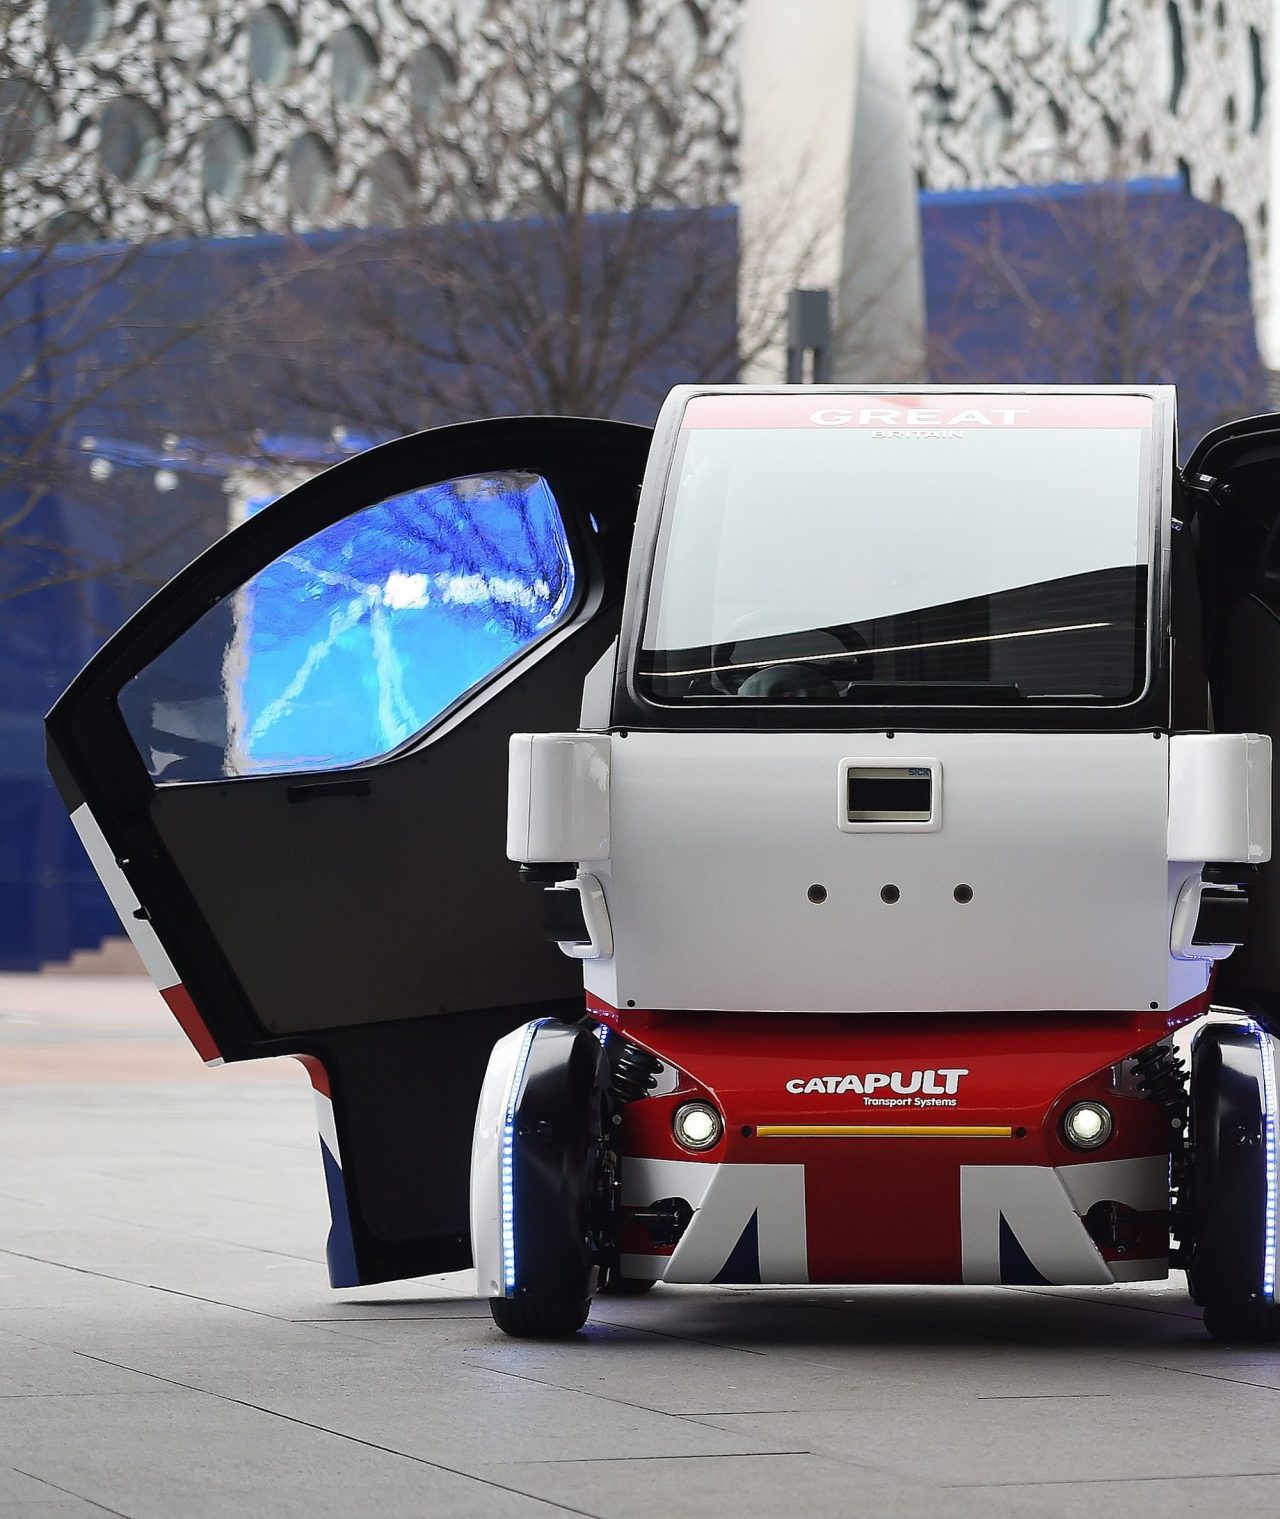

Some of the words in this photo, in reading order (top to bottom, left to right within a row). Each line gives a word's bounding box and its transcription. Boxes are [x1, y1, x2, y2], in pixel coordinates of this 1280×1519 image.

[808, 408, 1030, 426] GREAT
[871, 430, 965, 439] BRITAIN
[908, 768, 929, 776] SICK
[785, 1068, 969, 1095] CATAPULT
[863, 1097, 912, 1108] Transport
[914, 1097, 957, 1108] Systems
